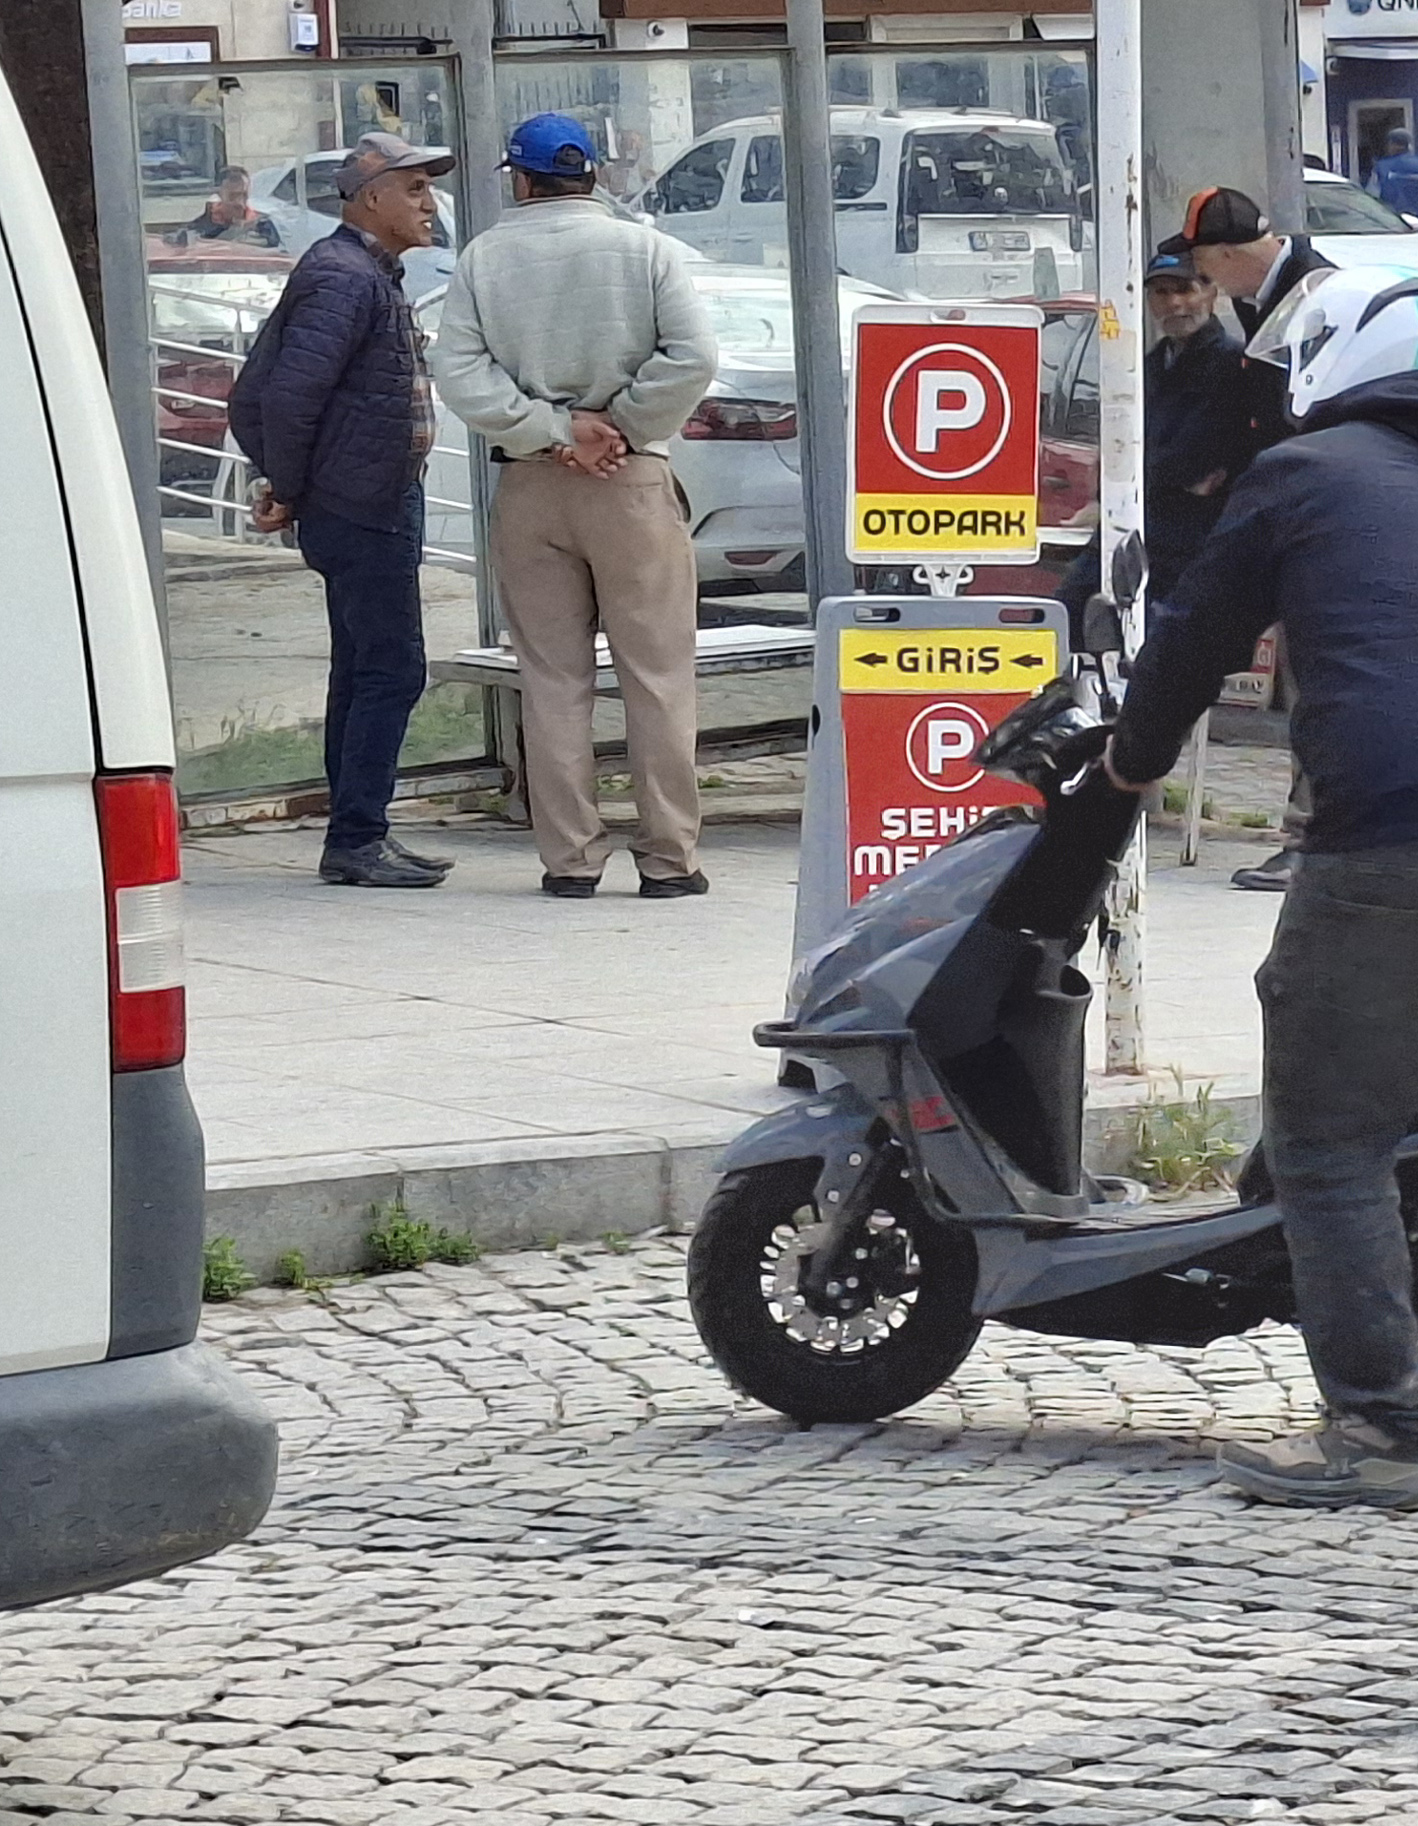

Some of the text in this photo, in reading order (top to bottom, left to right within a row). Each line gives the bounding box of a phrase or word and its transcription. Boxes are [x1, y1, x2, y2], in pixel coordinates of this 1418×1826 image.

[915, 369, 987, 453] P
[863, 508, 1027, 537] OTOPARK
[928, 719, 975, 775] P
